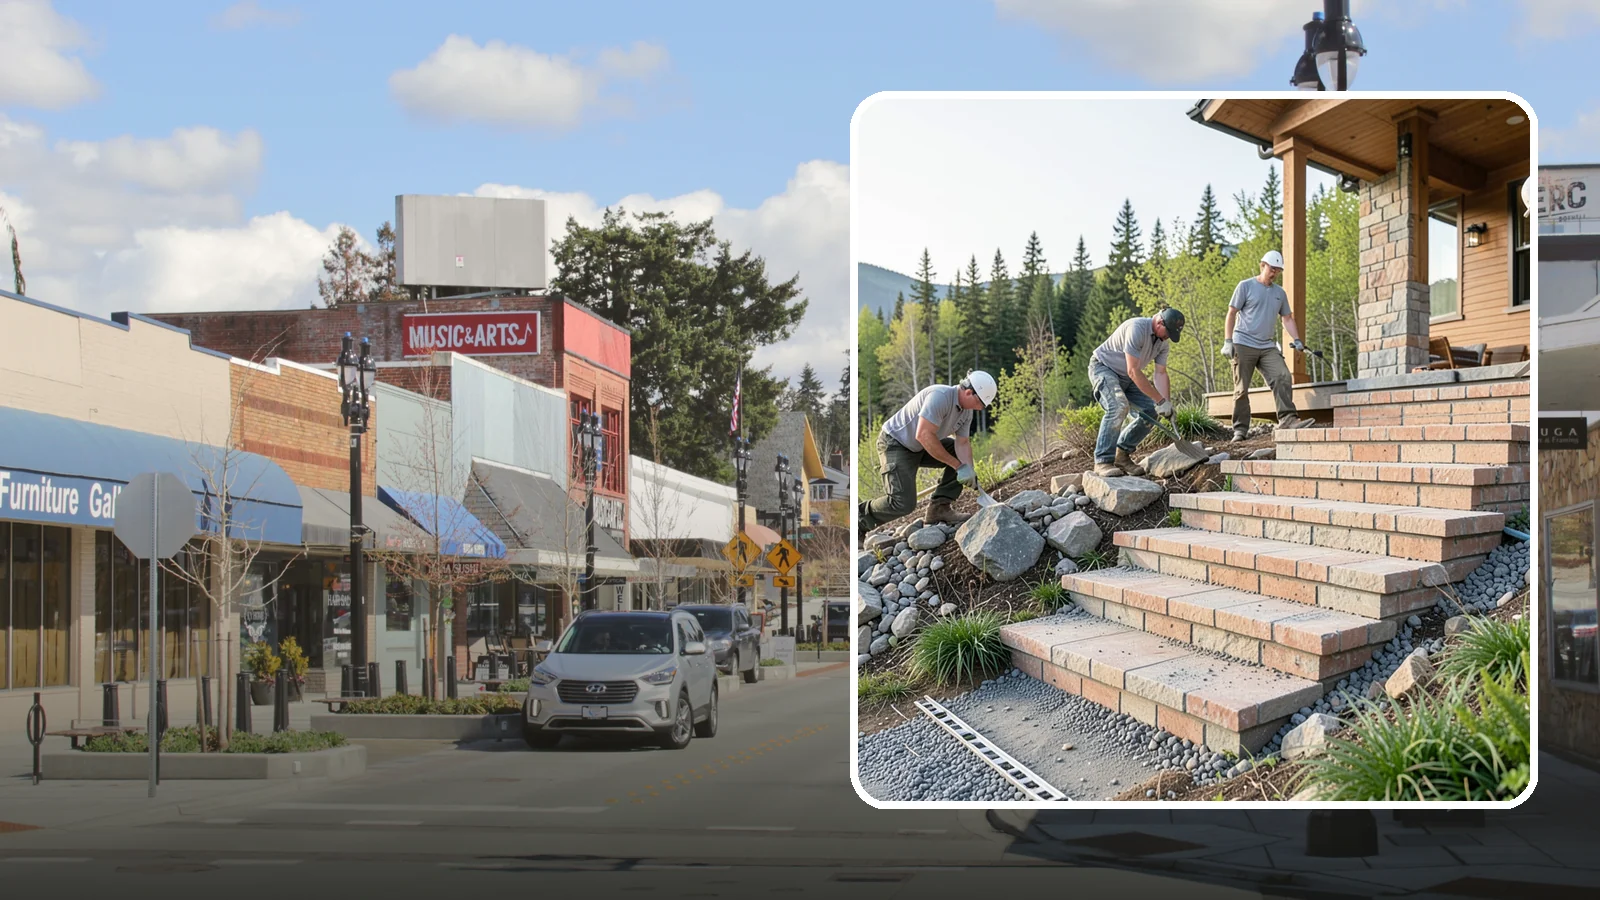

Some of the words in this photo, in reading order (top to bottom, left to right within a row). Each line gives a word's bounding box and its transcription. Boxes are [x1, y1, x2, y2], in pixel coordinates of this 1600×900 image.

[409, 323, 520, 349] MUSIC&ARTS
[1540, 427, 1578, 437] UGA
[0, 471, 79, 515] Furniture
[89, 482, 122, 519] Gal
[453, 563, 479, 574] SUSHI
